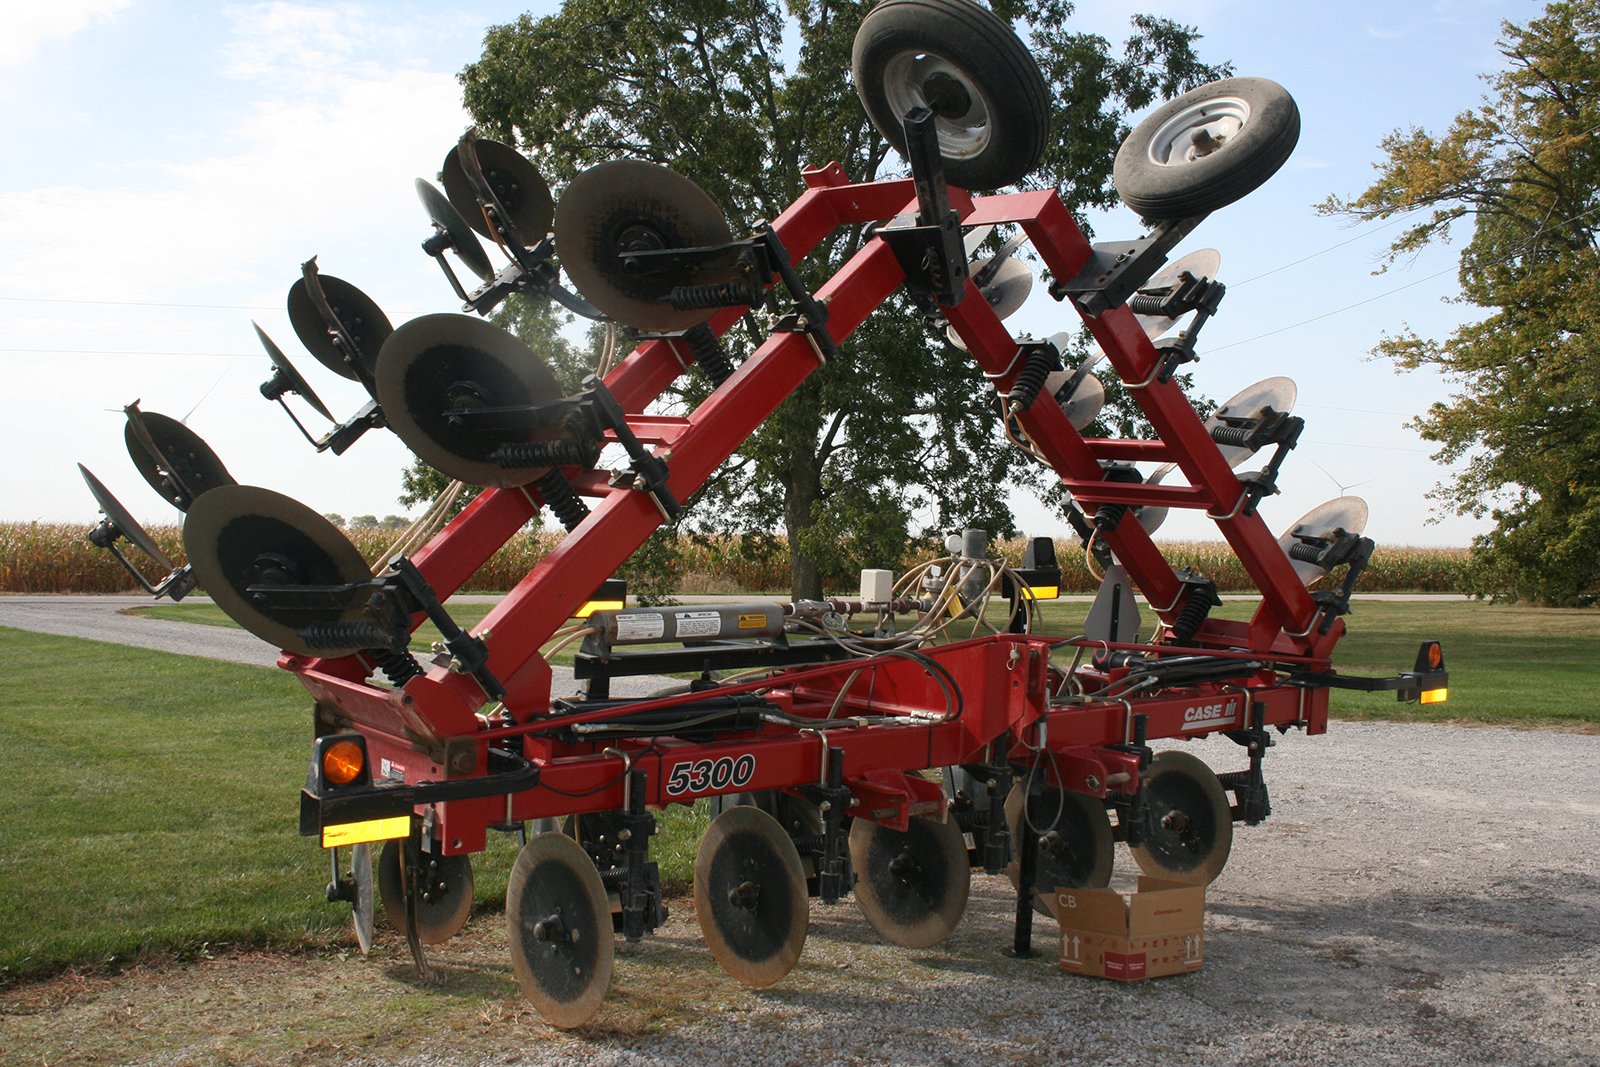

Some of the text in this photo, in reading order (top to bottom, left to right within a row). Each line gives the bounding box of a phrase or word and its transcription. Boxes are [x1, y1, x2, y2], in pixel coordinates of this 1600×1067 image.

[1184, 704, 1222, 721] CASE
[666, 753, 756, 796] 5300
[1059, 893, 1077, 909] CB
